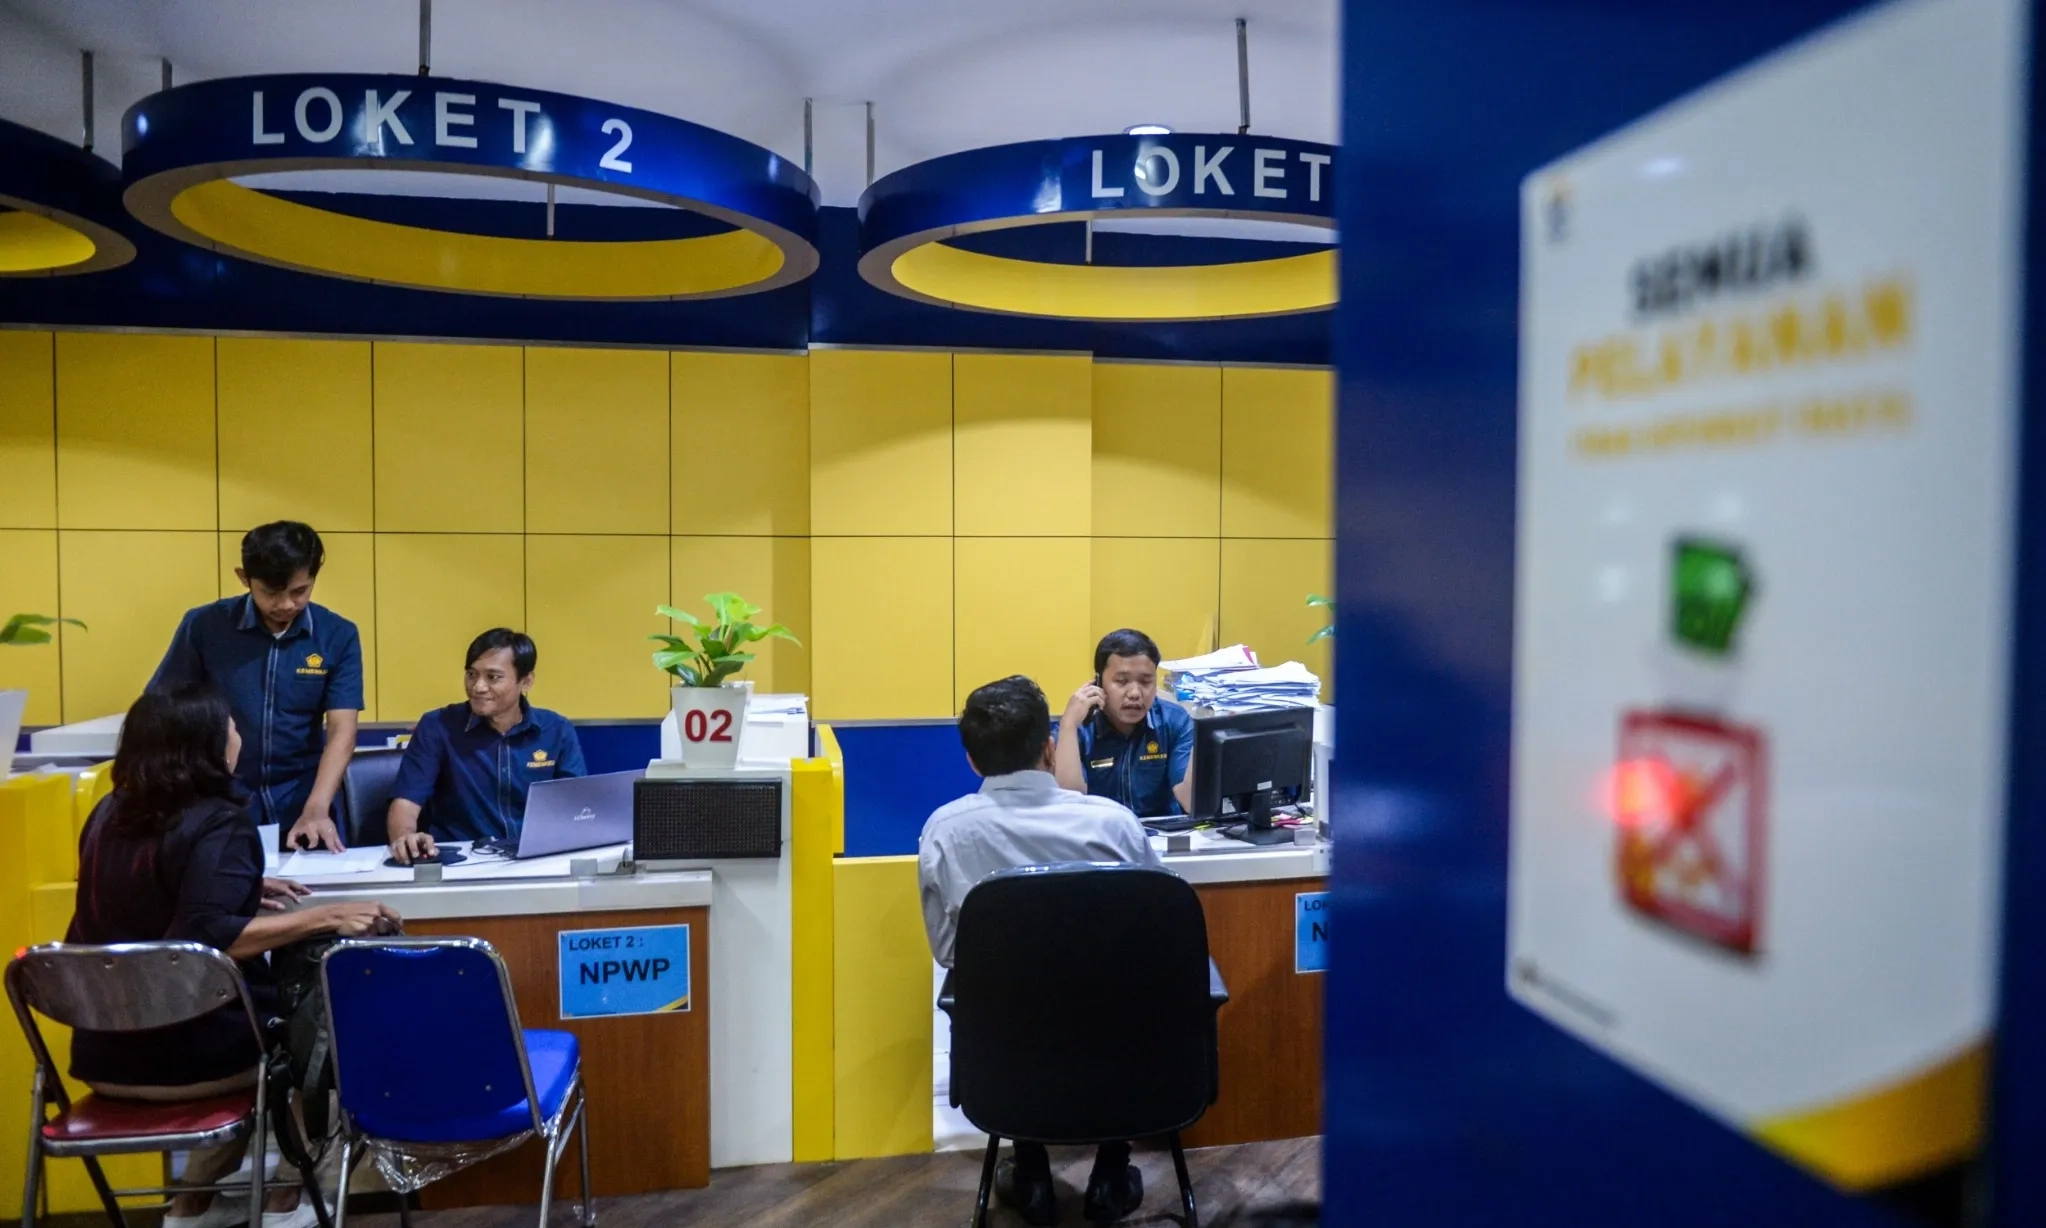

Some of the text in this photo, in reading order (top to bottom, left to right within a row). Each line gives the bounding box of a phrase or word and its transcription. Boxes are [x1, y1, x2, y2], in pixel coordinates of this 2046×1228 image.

[252, 87, 633, 173] LOKET 2
[1091, 145, 1332, 202] LOKET
[684, 709, 733, 743] 02
[569, 936, 622, 951] LOKET
[625, 935, 635, 948] 2
[579, 958, 670, 985] NPWP
